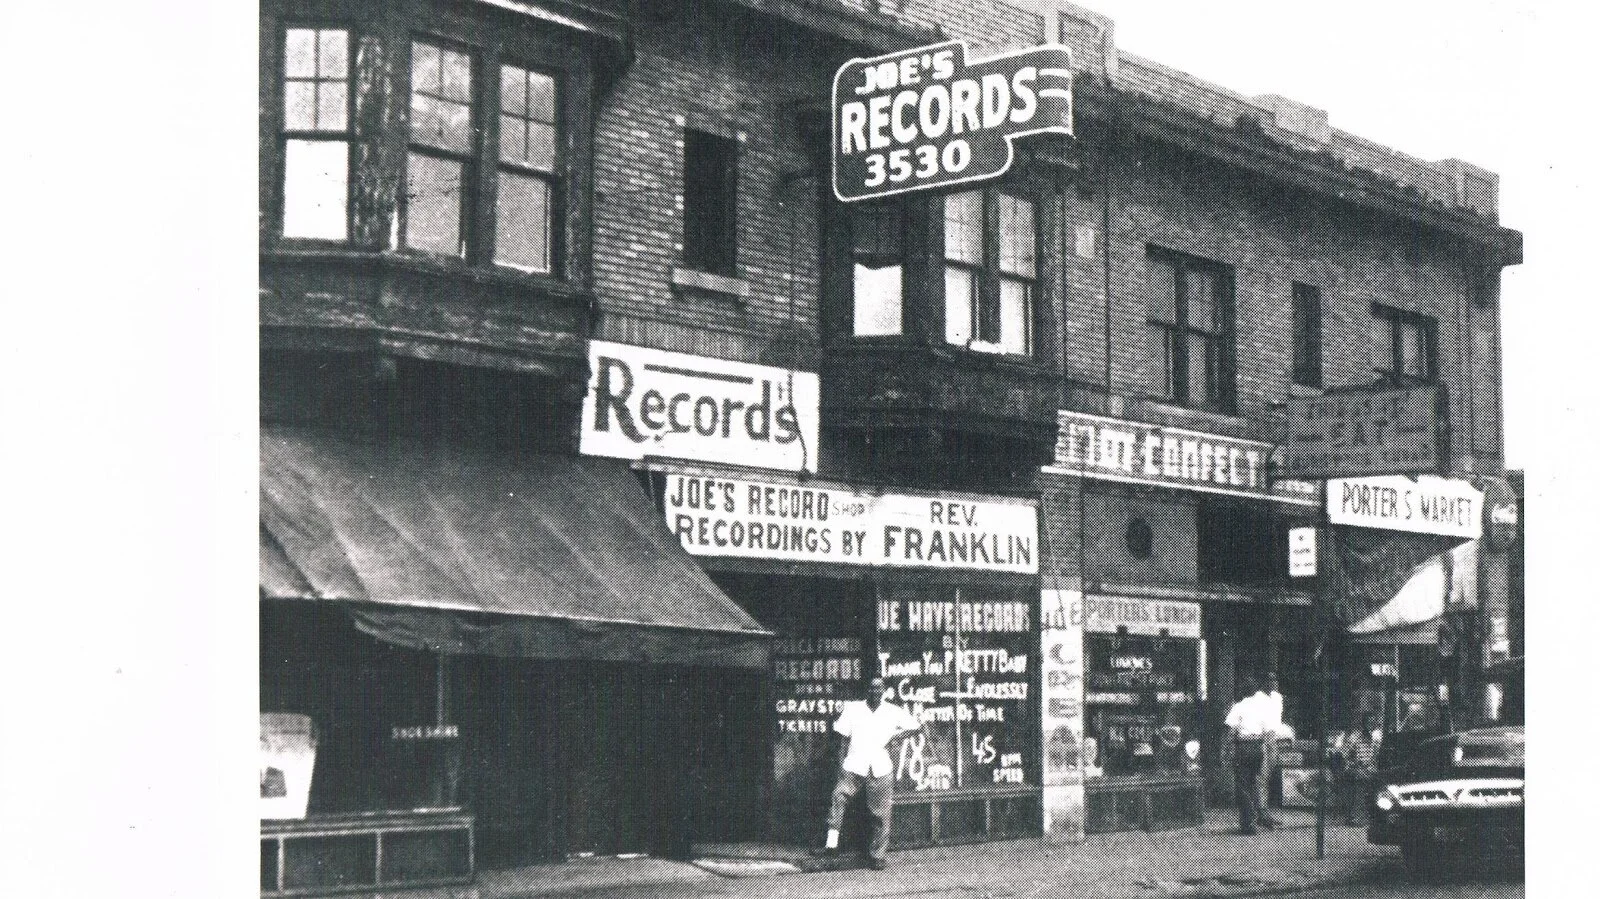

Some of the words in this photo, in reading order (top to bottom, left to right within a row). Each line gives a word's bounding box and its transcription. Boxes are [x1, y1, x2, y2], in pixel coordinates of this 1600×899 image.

[855, 50, 954, 95] JOE'S
[841, 66, 1037, 154] RECORDS
[864, 139, 971, 187] 3530
[670, 477, 735, 513] JOE'S
[748, 484, 829, 521] RECORD
[930, 500, 978, 527] REV.
[675, 513, 831, 553] RECORDINGS
[842, 530, 867, 557] BY
[884, 525, 1031, 565] FRANKLIN
[972, 732, 997, 765] 45
